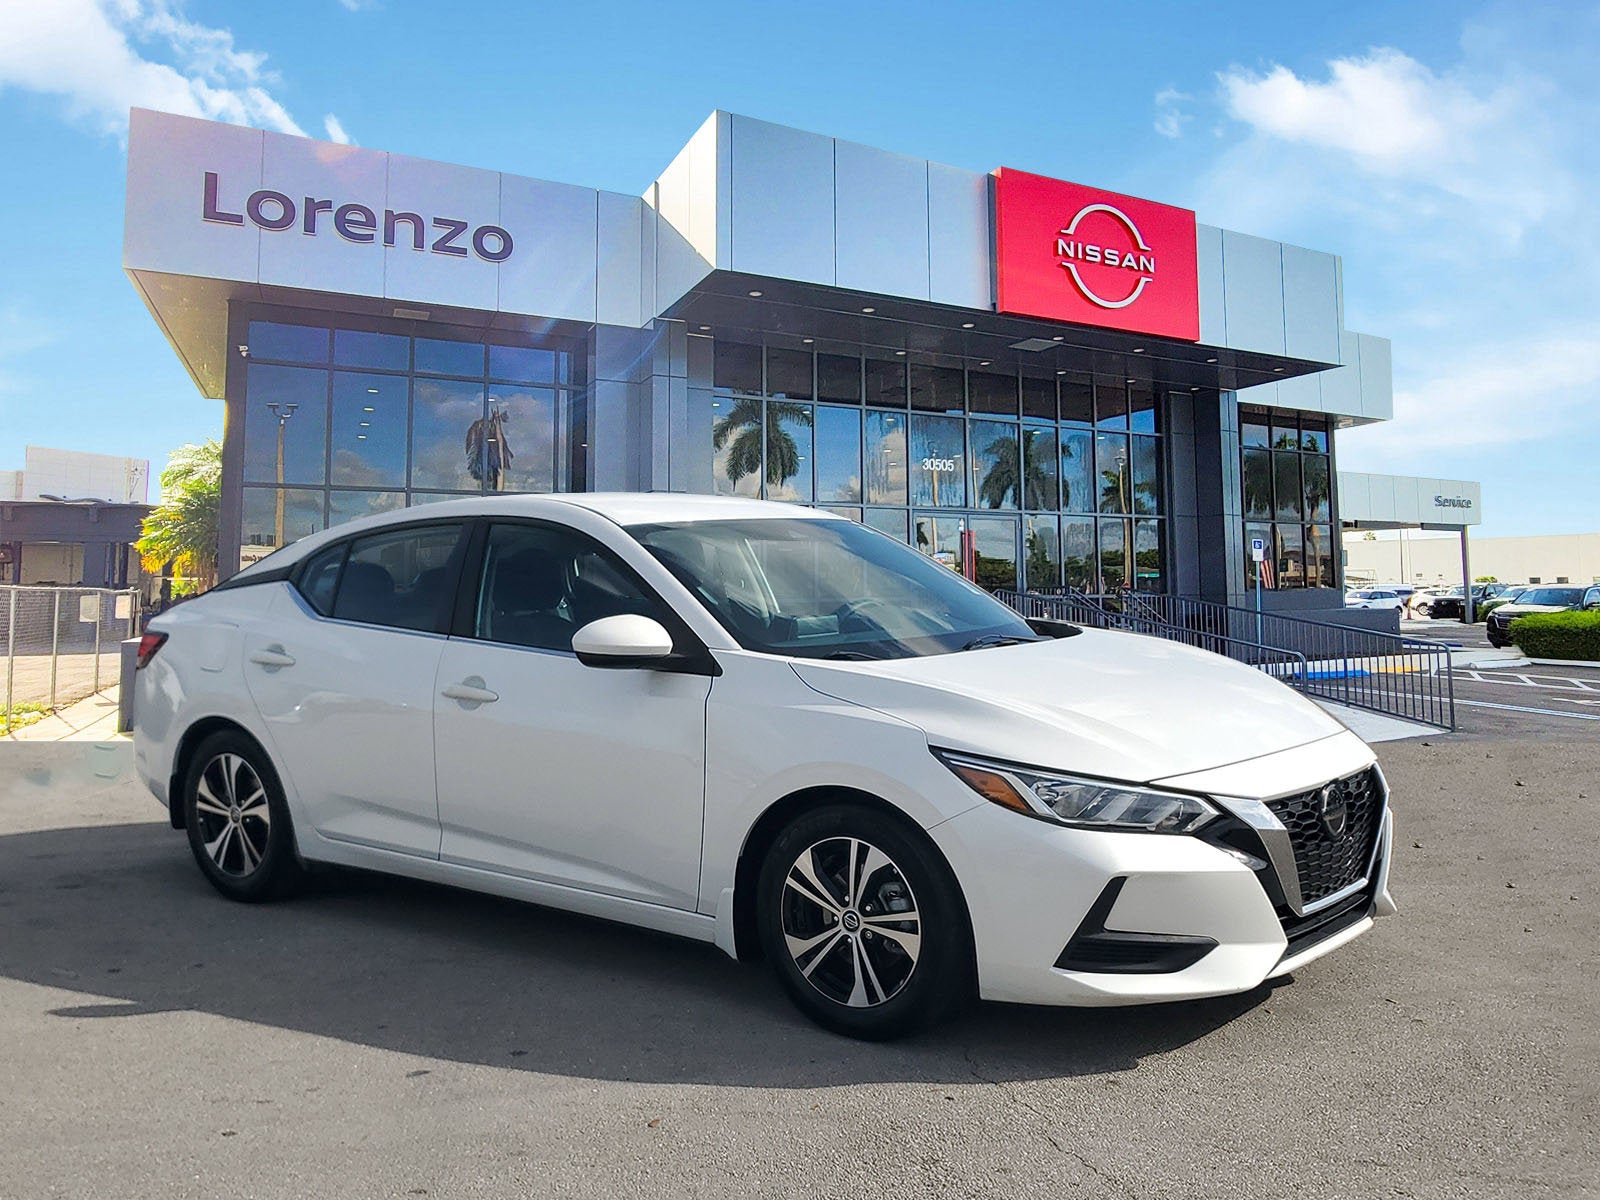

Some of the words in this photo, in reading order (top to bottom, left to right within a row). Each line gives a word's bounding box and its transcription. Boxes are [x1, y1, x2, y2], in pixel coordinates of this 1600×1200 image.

[203, 171, 514, 262] Lorenzo
[1057, 238, 1155, 273] NISSAN
[922, 457, 955, 472] 30505
[1434, 495, 1472, 508] Service
